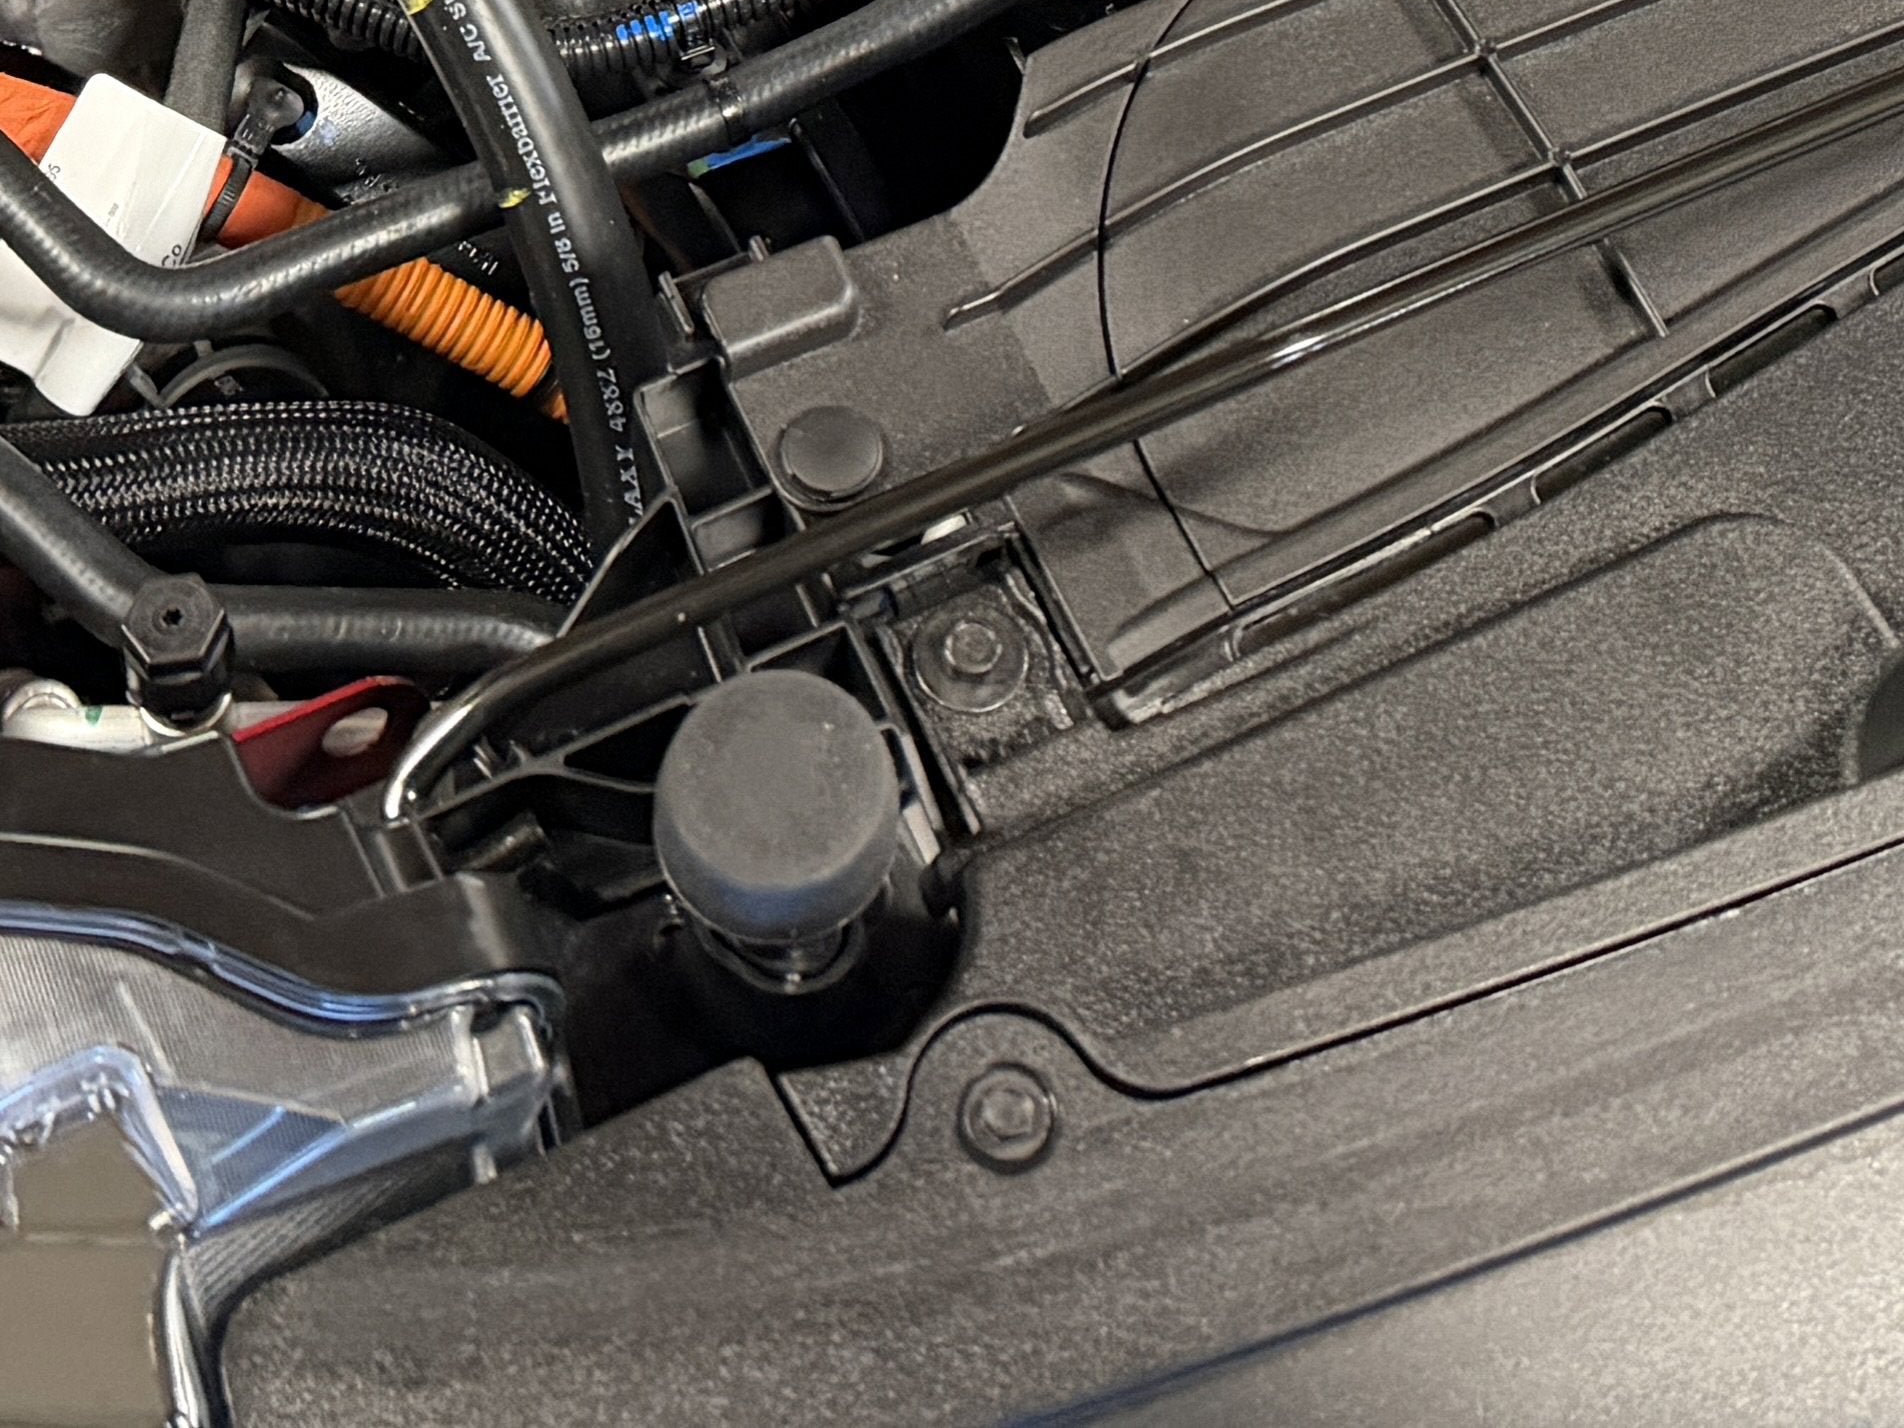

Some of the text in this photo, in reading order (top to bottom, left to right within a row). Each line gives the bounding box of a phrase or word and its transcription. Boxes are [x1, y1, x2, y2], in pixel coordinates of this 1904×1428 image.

[459, 23, 492, 62] A/C
[486, 73, 558, 205] Flexbarrier
[569, 276, 611, 361] (16mm)
